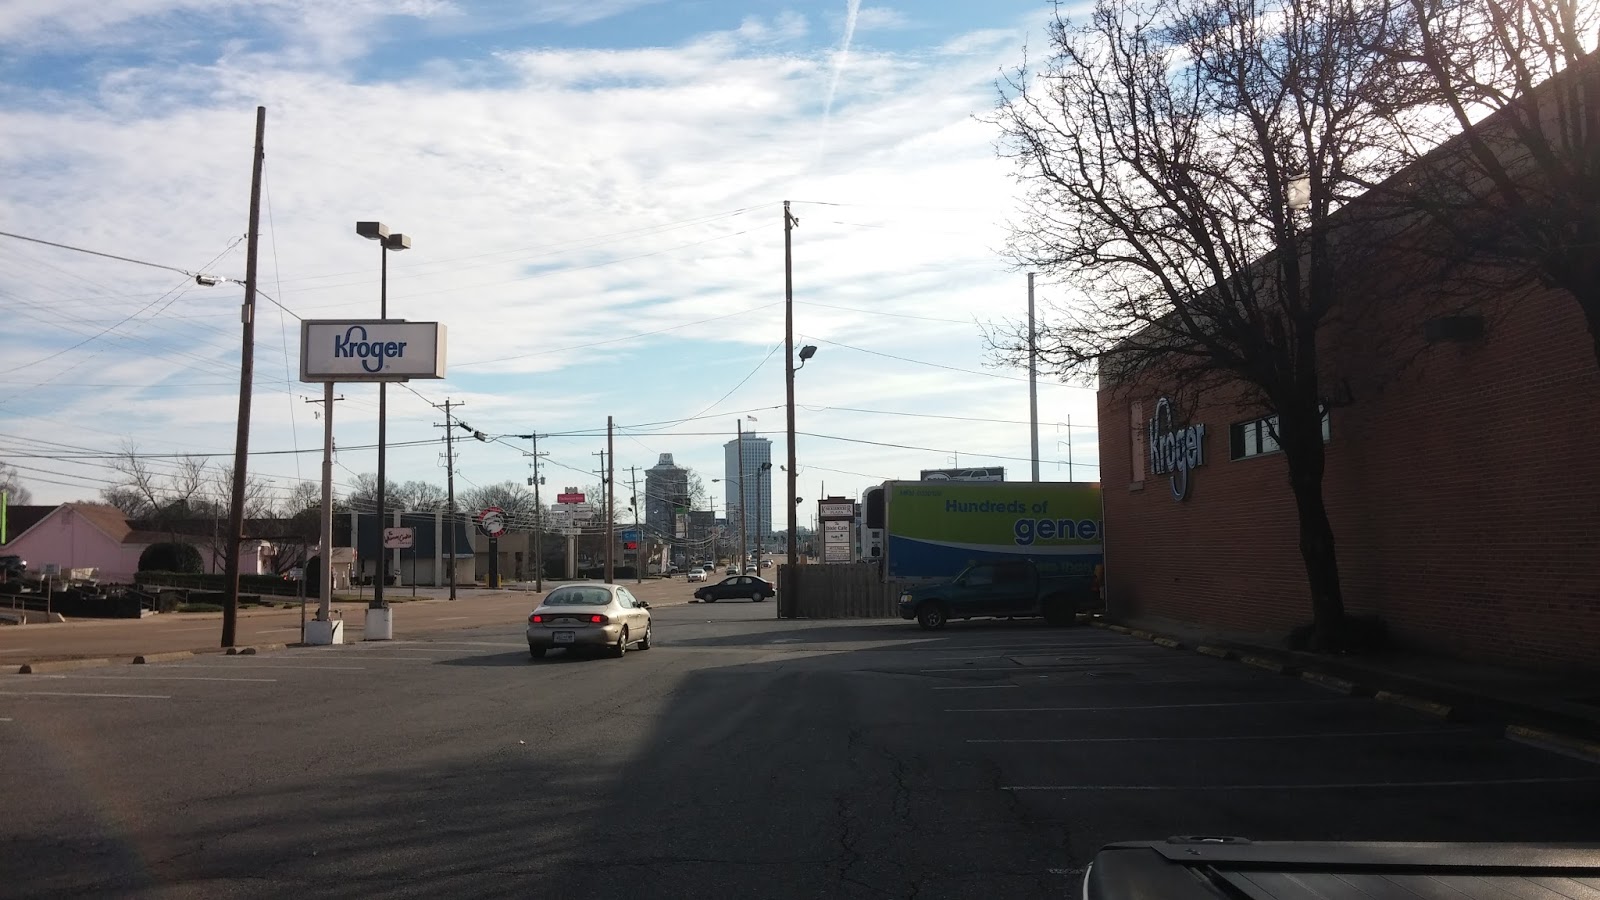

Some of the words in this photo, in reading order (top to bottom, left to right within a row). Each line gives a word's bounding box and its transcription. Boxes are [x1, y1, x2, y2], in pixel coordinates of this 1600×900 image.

[334, 325, 407, 373] Kroger
[1149, 396, 1206, 502] Kroger
[945, 499, 1026, 513] Hundreds
[1031, 500, 1048, 514] of
